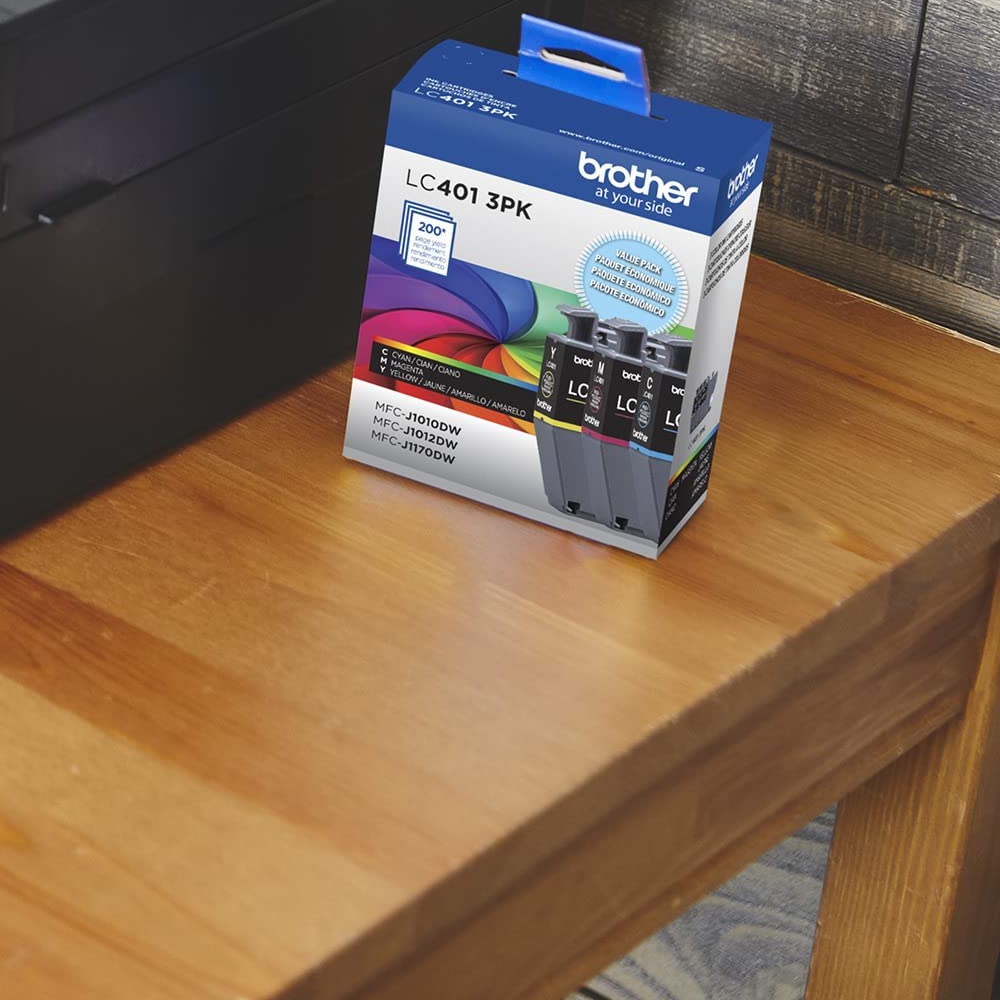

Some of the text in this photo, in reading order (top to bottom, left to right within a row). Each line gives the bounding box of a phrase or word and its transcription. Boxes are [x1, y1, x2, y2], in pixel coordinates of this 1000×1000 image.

[414, 87, 518, 120] LC401 3PK
[578, 150, 700, 207] brother
[406, 168, 534, 221] LC401 3PK
[595, 187, 674, 217] at your side
[590, 265, 626, 287] PAQUETE
[594, 253, 625, 273] PAQUET
[615, 248, 663, 276] VALUE PACK
[589, 278, 620, 298] PACOTE
[380, 356, 425, 377] M MAGENTA
[381, 348, 389, 357] C
[391, 350, 412, 364] CYAN
[437, 365, 462, 379] CIANO
[380, 365, 528, 419] Y YELLOW JAUNE AMARILLO AMARELO
[567, 379, 590, 399] LC
[616, 394, 638, 414] LC
[372, 415, 459, 451] MFC-J1012DW
[374, 400, 462, 436] MFC-J1010DW
[371, 429, 456, 465] MFC-J1170DW
